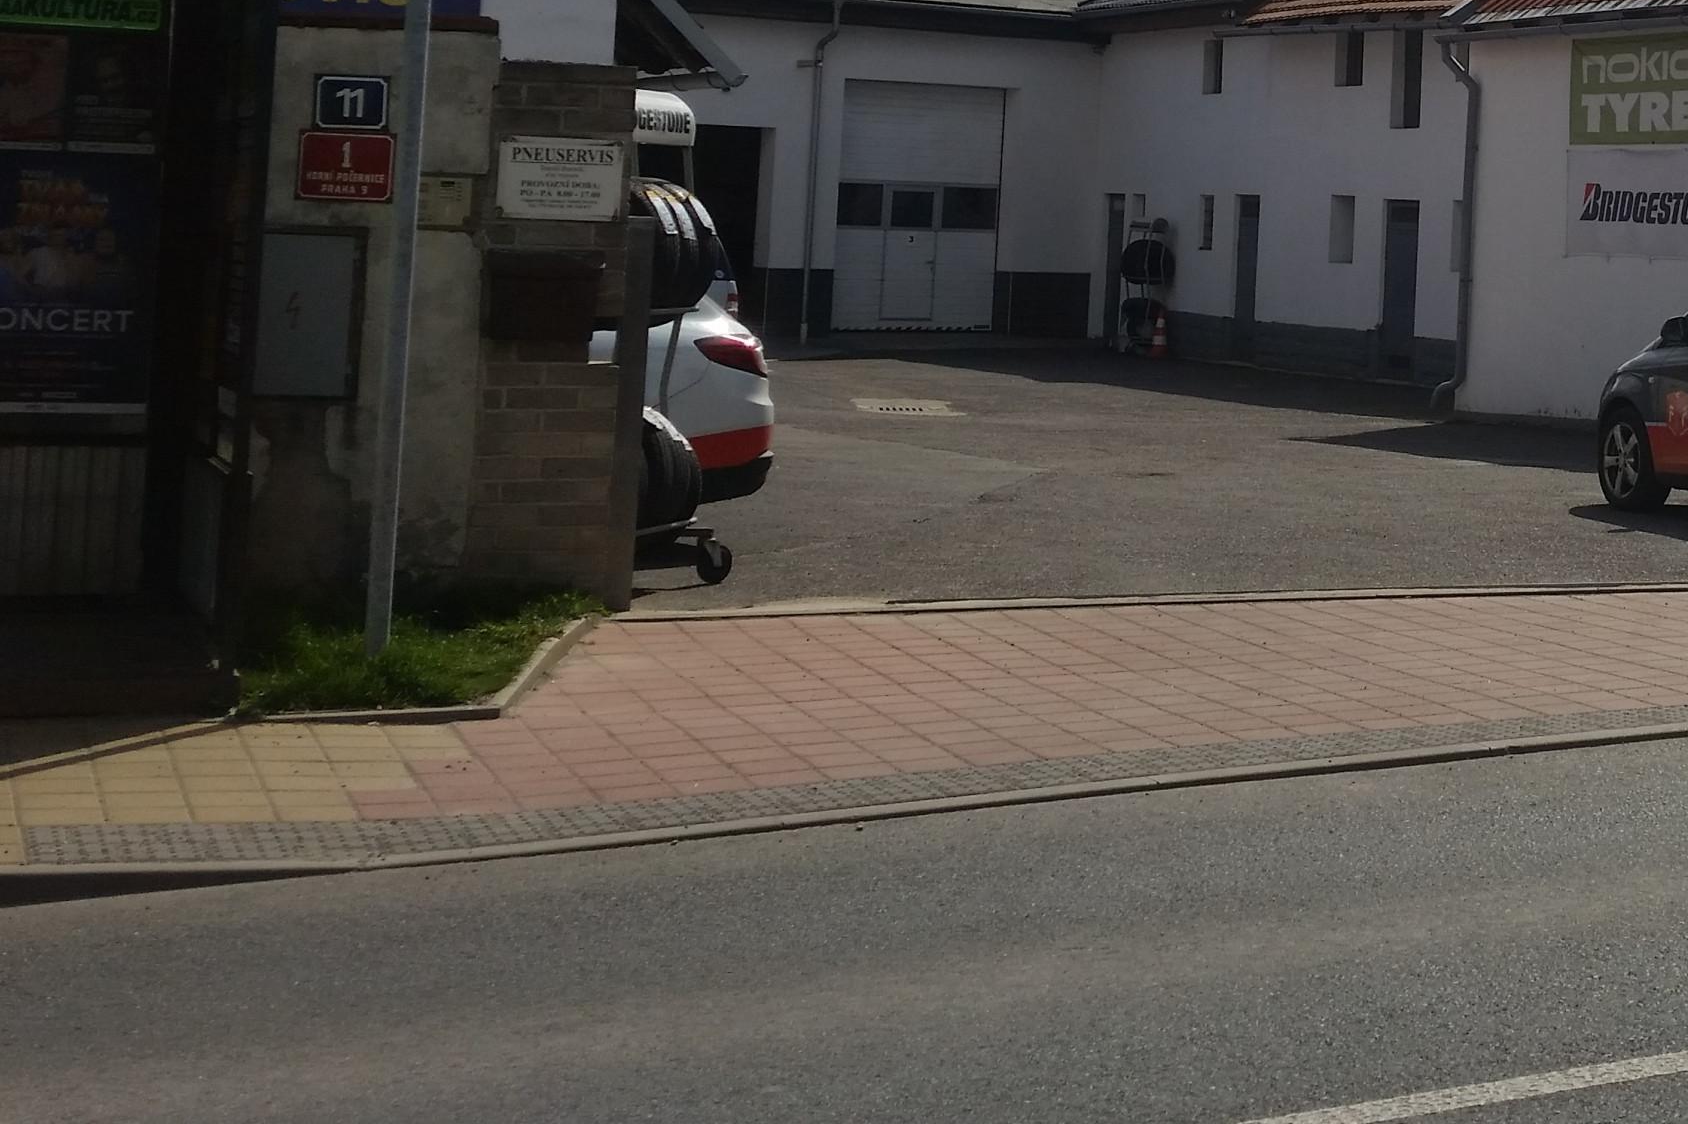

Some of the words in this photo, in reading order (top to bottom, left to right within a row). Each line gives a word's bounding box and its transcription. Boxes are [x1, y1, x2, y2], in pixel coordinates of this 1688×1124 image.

[336, 88, 365, 118] 11
[341, 141, 352, 168] 1
[512, 147, 614, 163] PNEUSERVIS
[320, 183, 356, 194] PRAHA
[0, 307, 135, 333] ONCERT
